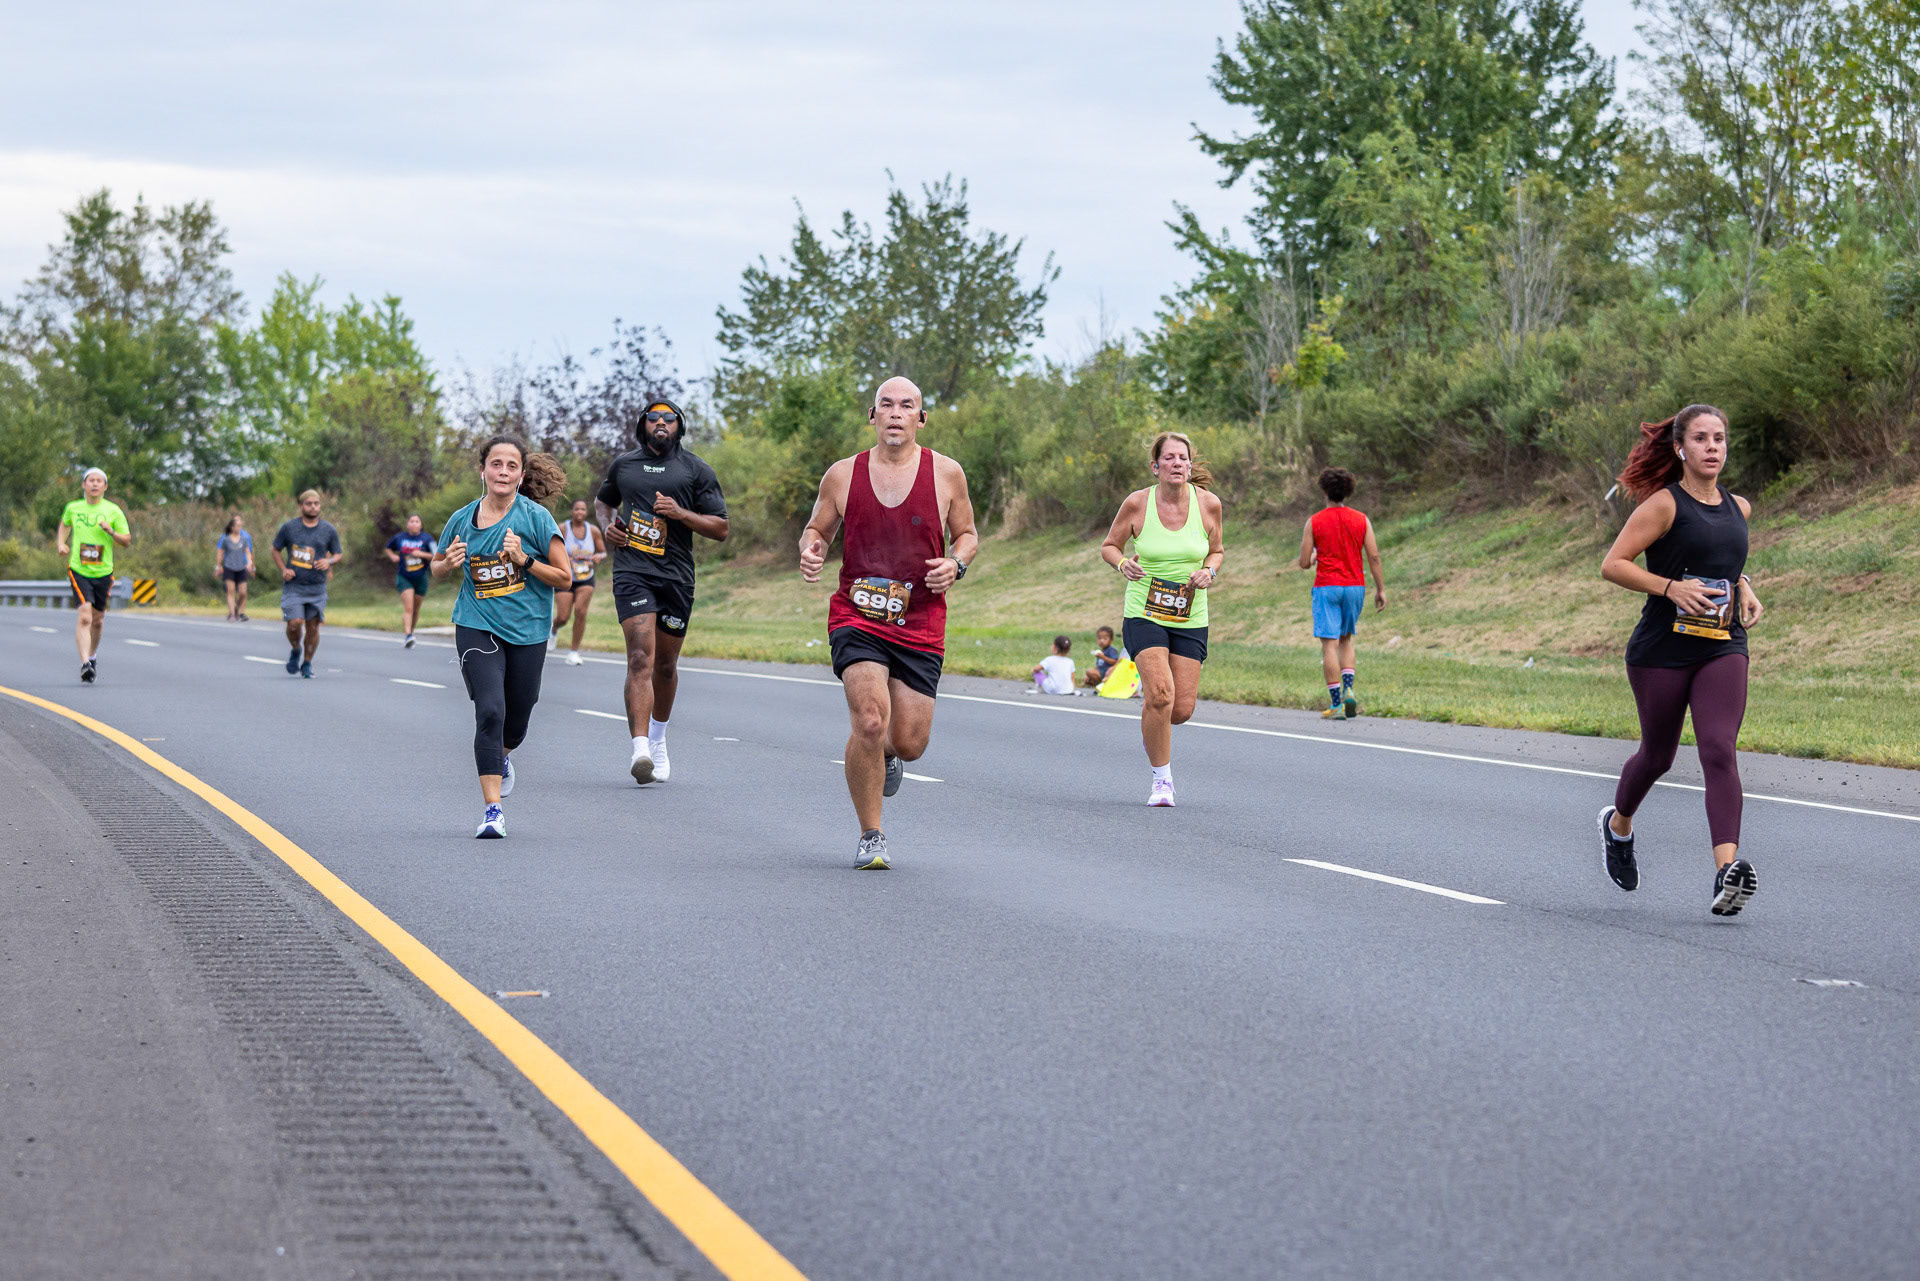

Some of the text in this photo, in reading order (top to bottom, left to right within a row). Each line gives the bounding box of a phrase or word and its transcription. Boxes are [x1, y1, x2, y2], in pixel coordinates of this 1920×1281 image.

[633, 521, 661, 540] 179
[477, 562, 515, 581] 361
[1151, 585, 1170, 593] CHASE
[853, 590, 904, 613] 696
[1154, 591, 1188, 609] 138
